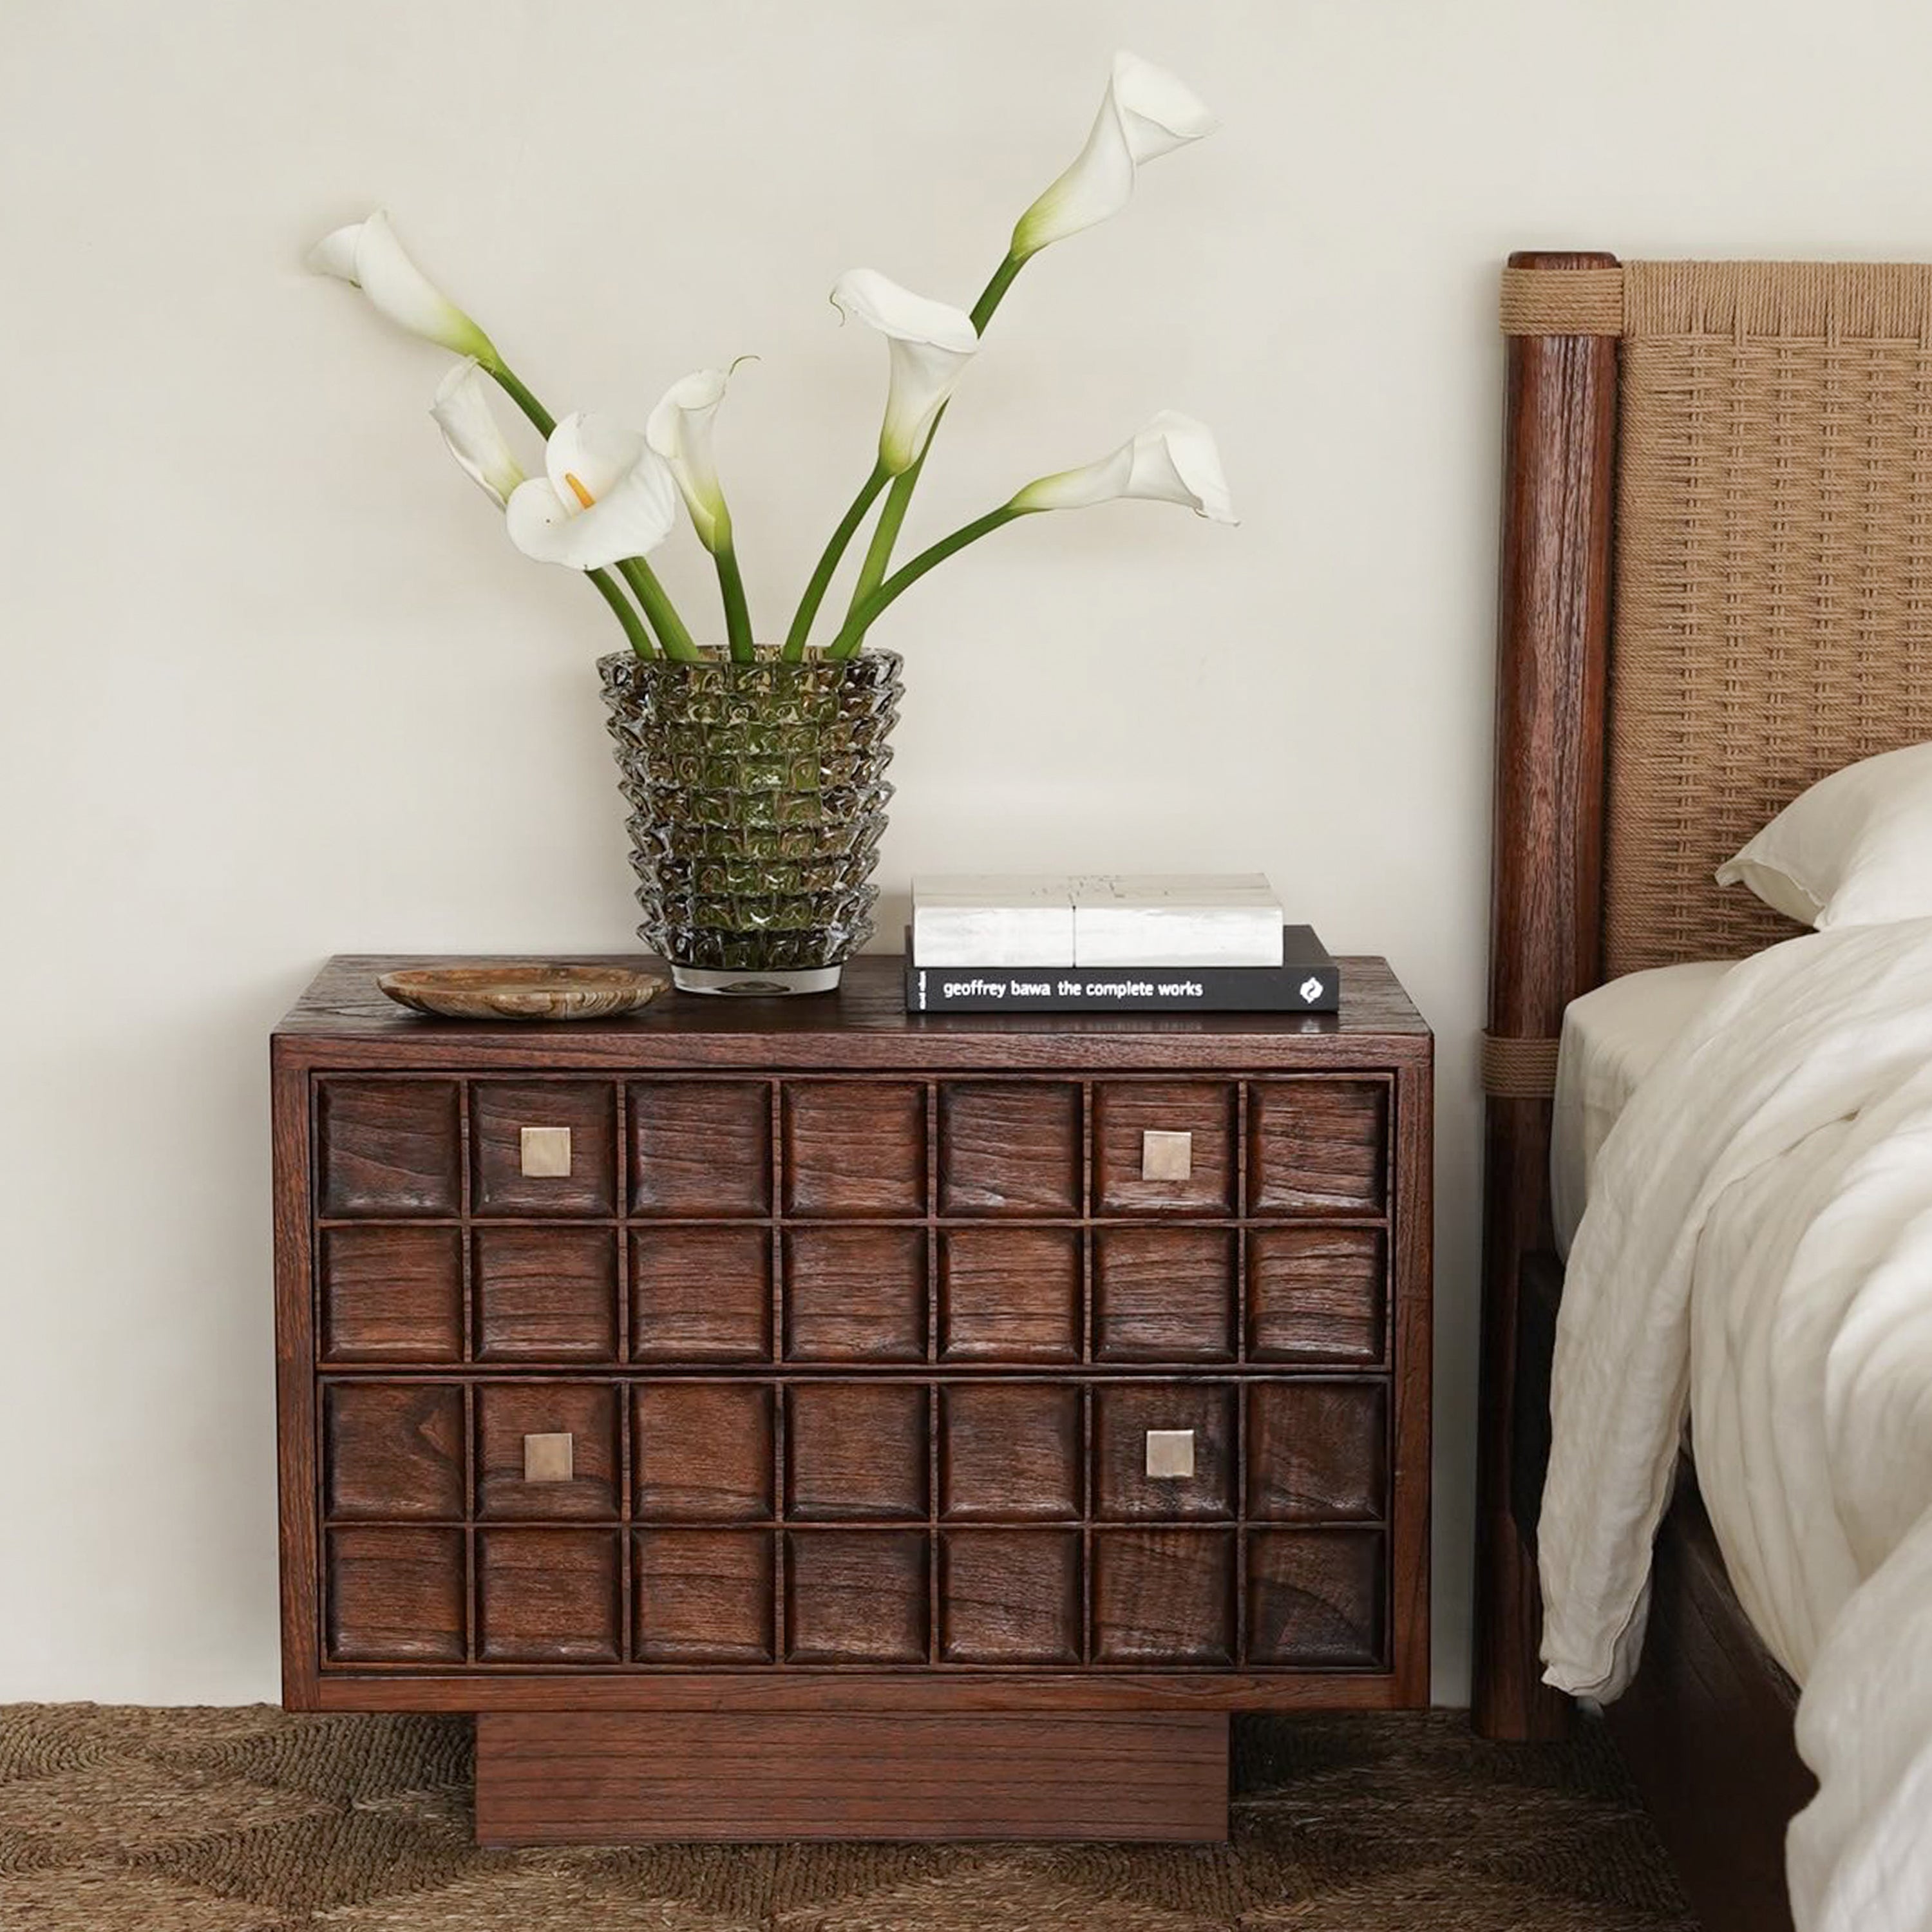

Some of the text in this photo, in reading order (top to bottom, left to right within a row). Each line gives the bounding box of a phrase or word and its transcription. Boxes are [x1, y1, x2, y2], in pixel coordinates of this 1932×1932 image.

[943, 979, 1007, 999] geoffrey
[1010, 980, 1051, 996] bawa
[1057, 980, 1083, 996] the
[1085, 980, 1155, 1000] complete
[1157, 980, 1204, 997] works
